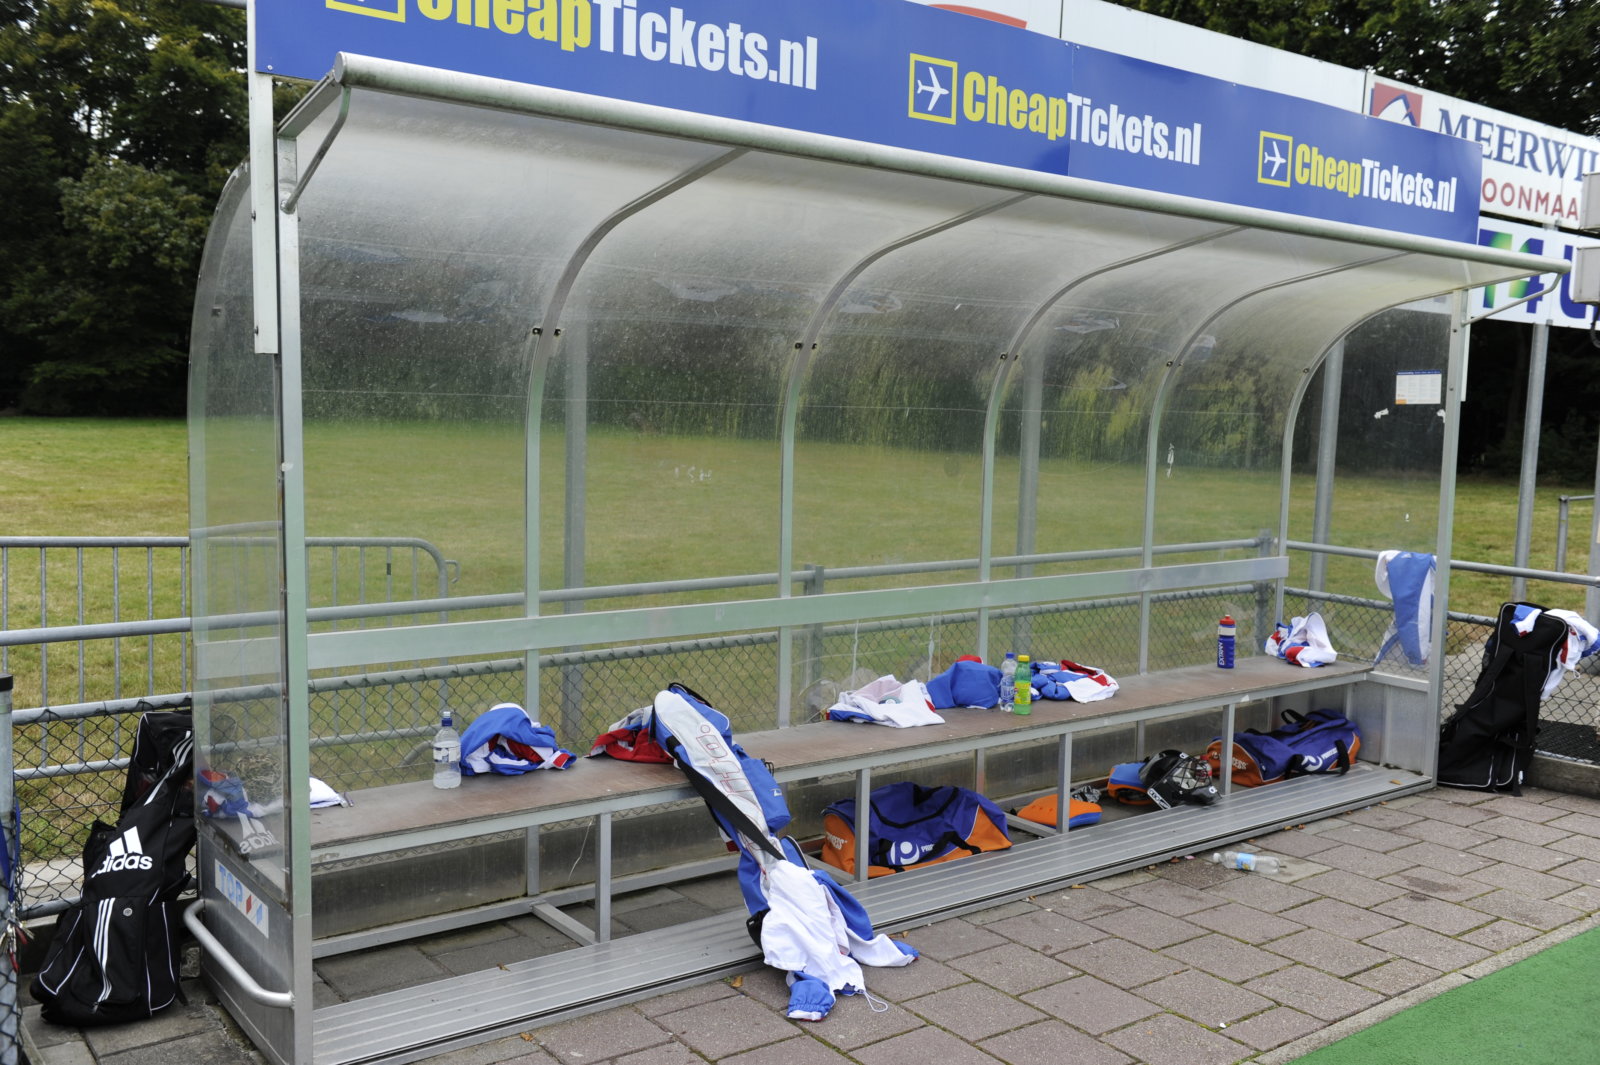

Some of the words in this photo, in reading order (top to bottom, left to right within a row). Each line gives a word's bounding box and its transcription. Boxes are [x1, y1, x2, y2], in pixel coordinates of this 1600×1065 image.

[962, 71, 1202, 166] CheapTickets.nl
[1294, 143, 1457, 213] CheapTickets.nl
[91, 852, 154, 879] didas
[219, 864, 243, 906] TOP
